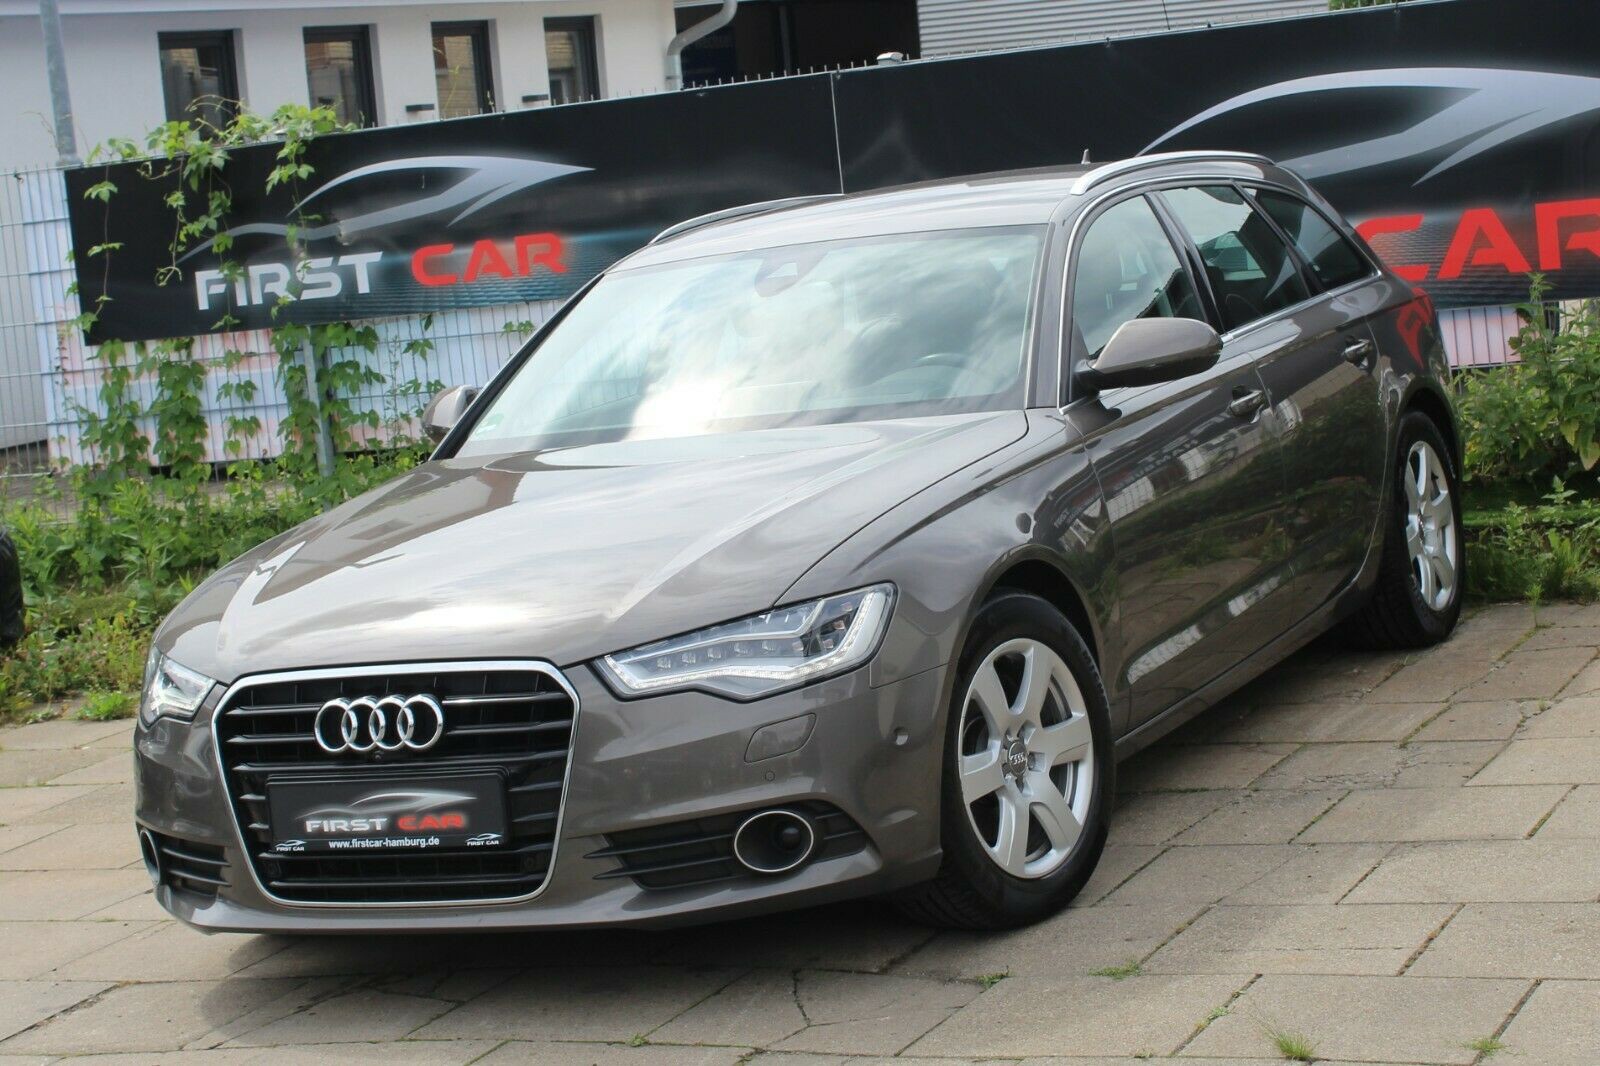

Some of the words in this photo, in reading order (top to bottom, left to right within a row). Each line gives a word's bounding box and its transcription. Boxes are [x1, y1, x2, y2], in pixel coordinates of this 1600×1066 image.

[195, 251, 383, 310] FIRST
[411, 232, 567, 286] CAR
[306, 818, 388, 832] FIRST
[398, 814, 465, 830] CAR
[328, 837, 440, 848] www.firstcar-hamburg.de
